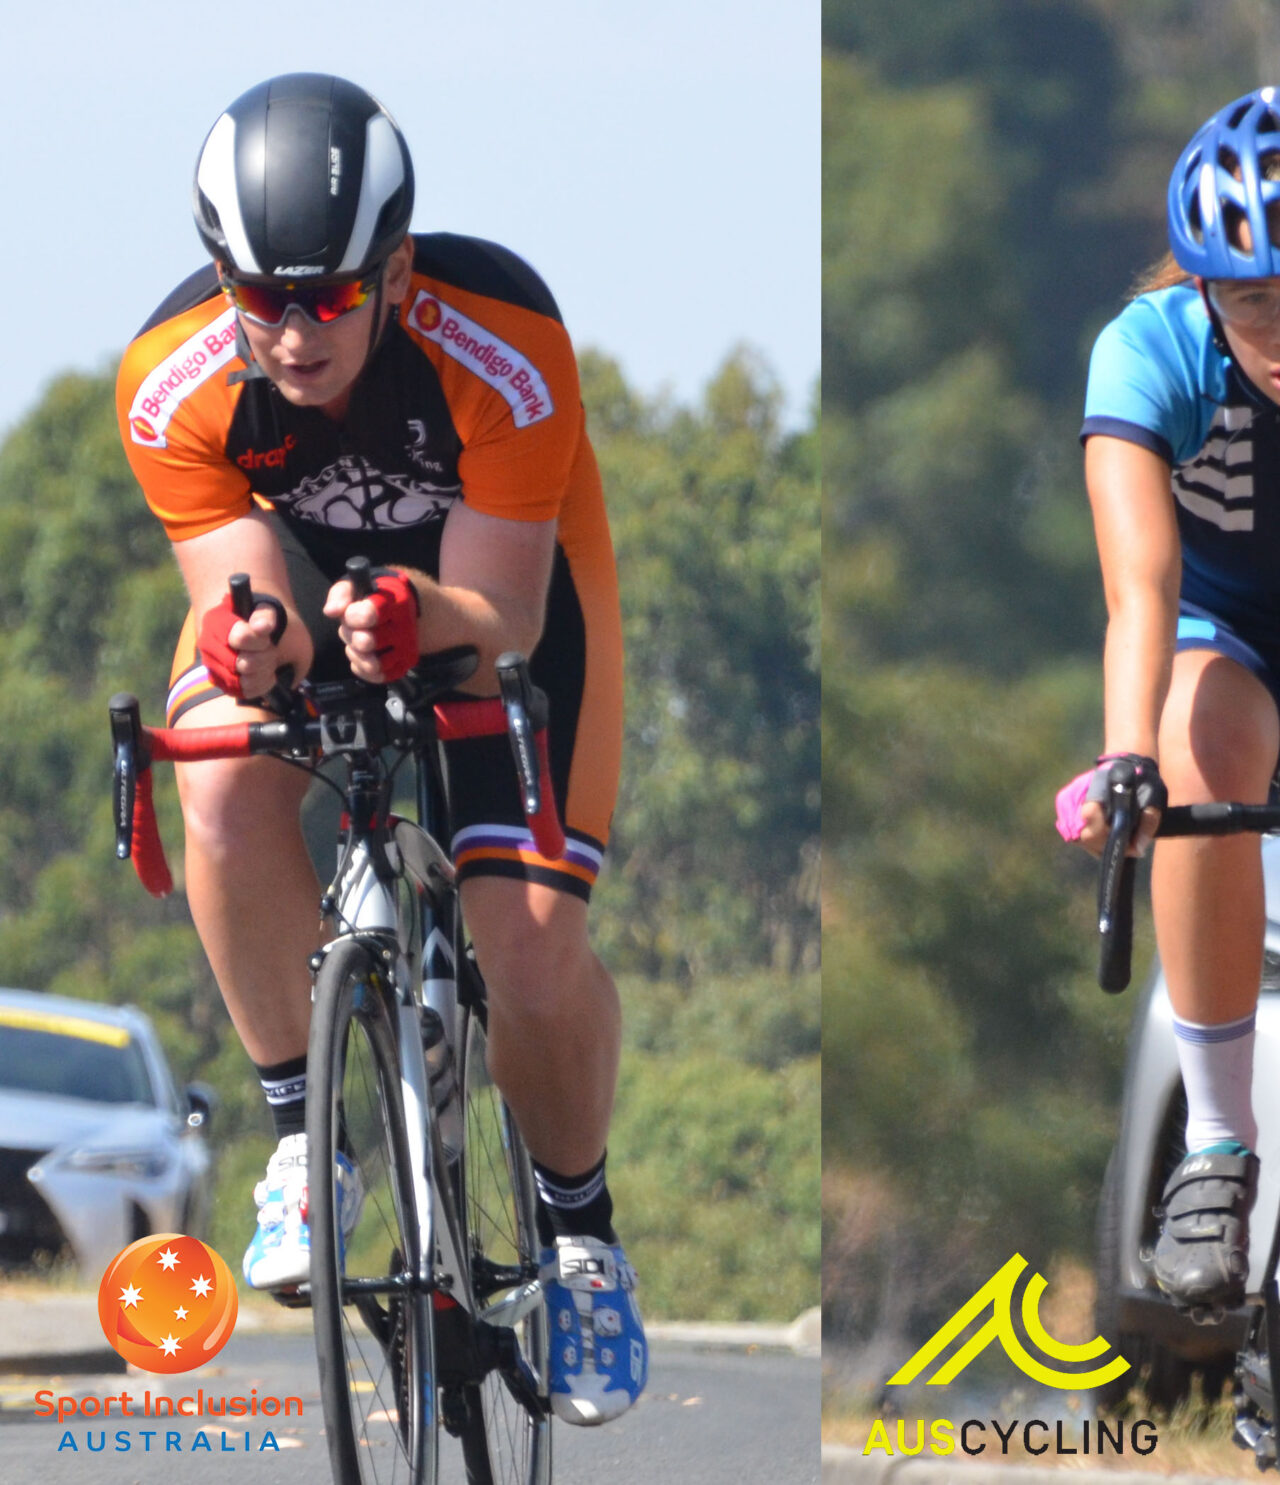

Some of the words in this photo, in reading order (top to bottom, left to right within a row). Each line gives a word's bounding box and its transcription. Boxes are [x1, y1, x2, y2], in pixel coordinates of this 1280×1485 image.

[273, 265, 324, 276] LAZER
[141, 351, 207, 418] Bendigo
[441, 318, 513, 377] Bendigo
[508, 368, 545, 421] Bank
